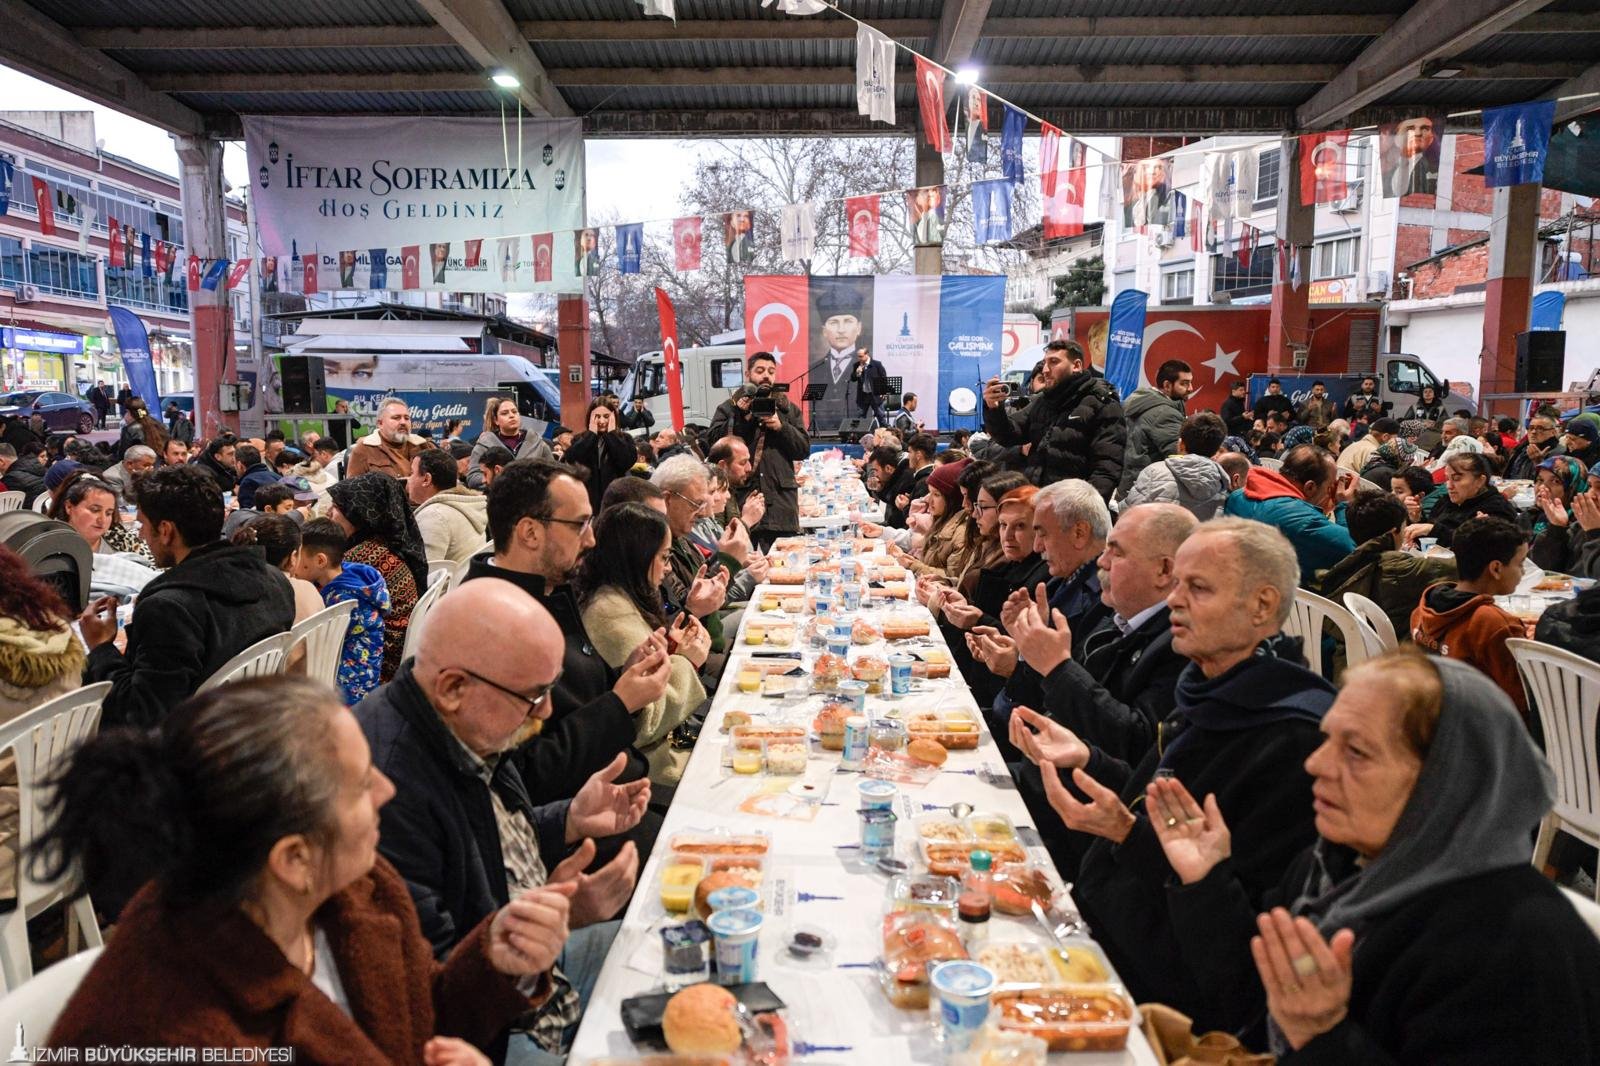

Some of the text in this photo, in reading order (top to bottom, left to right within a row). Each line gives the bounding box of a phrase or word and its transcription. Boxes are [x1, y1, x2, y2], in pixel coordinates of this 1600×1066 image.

[286, 153, 536, 196] İFTAR SOFRAMIZA
[318, 199, 504, 220] HOŞ GELDİNİZ
[323, 256, 337, 265] Dr.
[431, 404, 468, 420] Geldin
